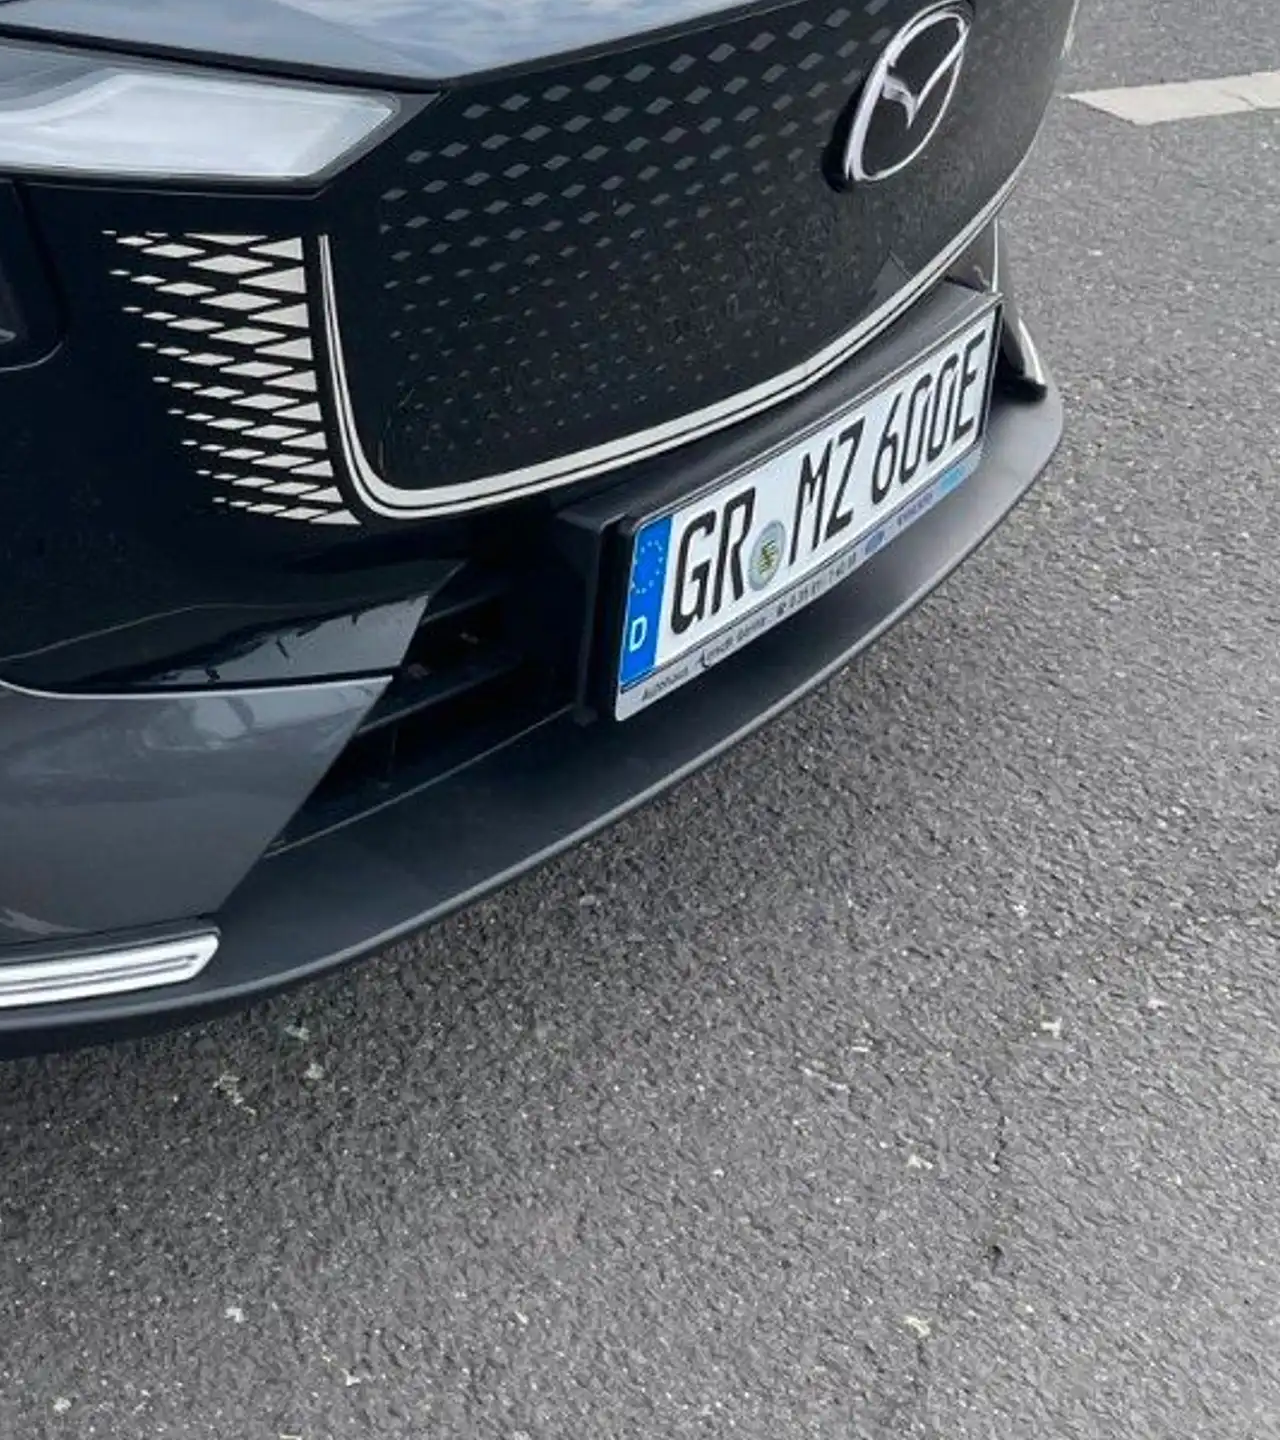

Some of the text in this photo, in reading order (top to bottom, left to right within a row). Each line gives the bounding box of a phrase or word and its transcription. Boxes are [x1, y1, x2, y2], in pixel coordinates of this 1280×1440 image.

[669, 328, 987, 635] GR MZ 600E
[628, 616, 648, 653] D
